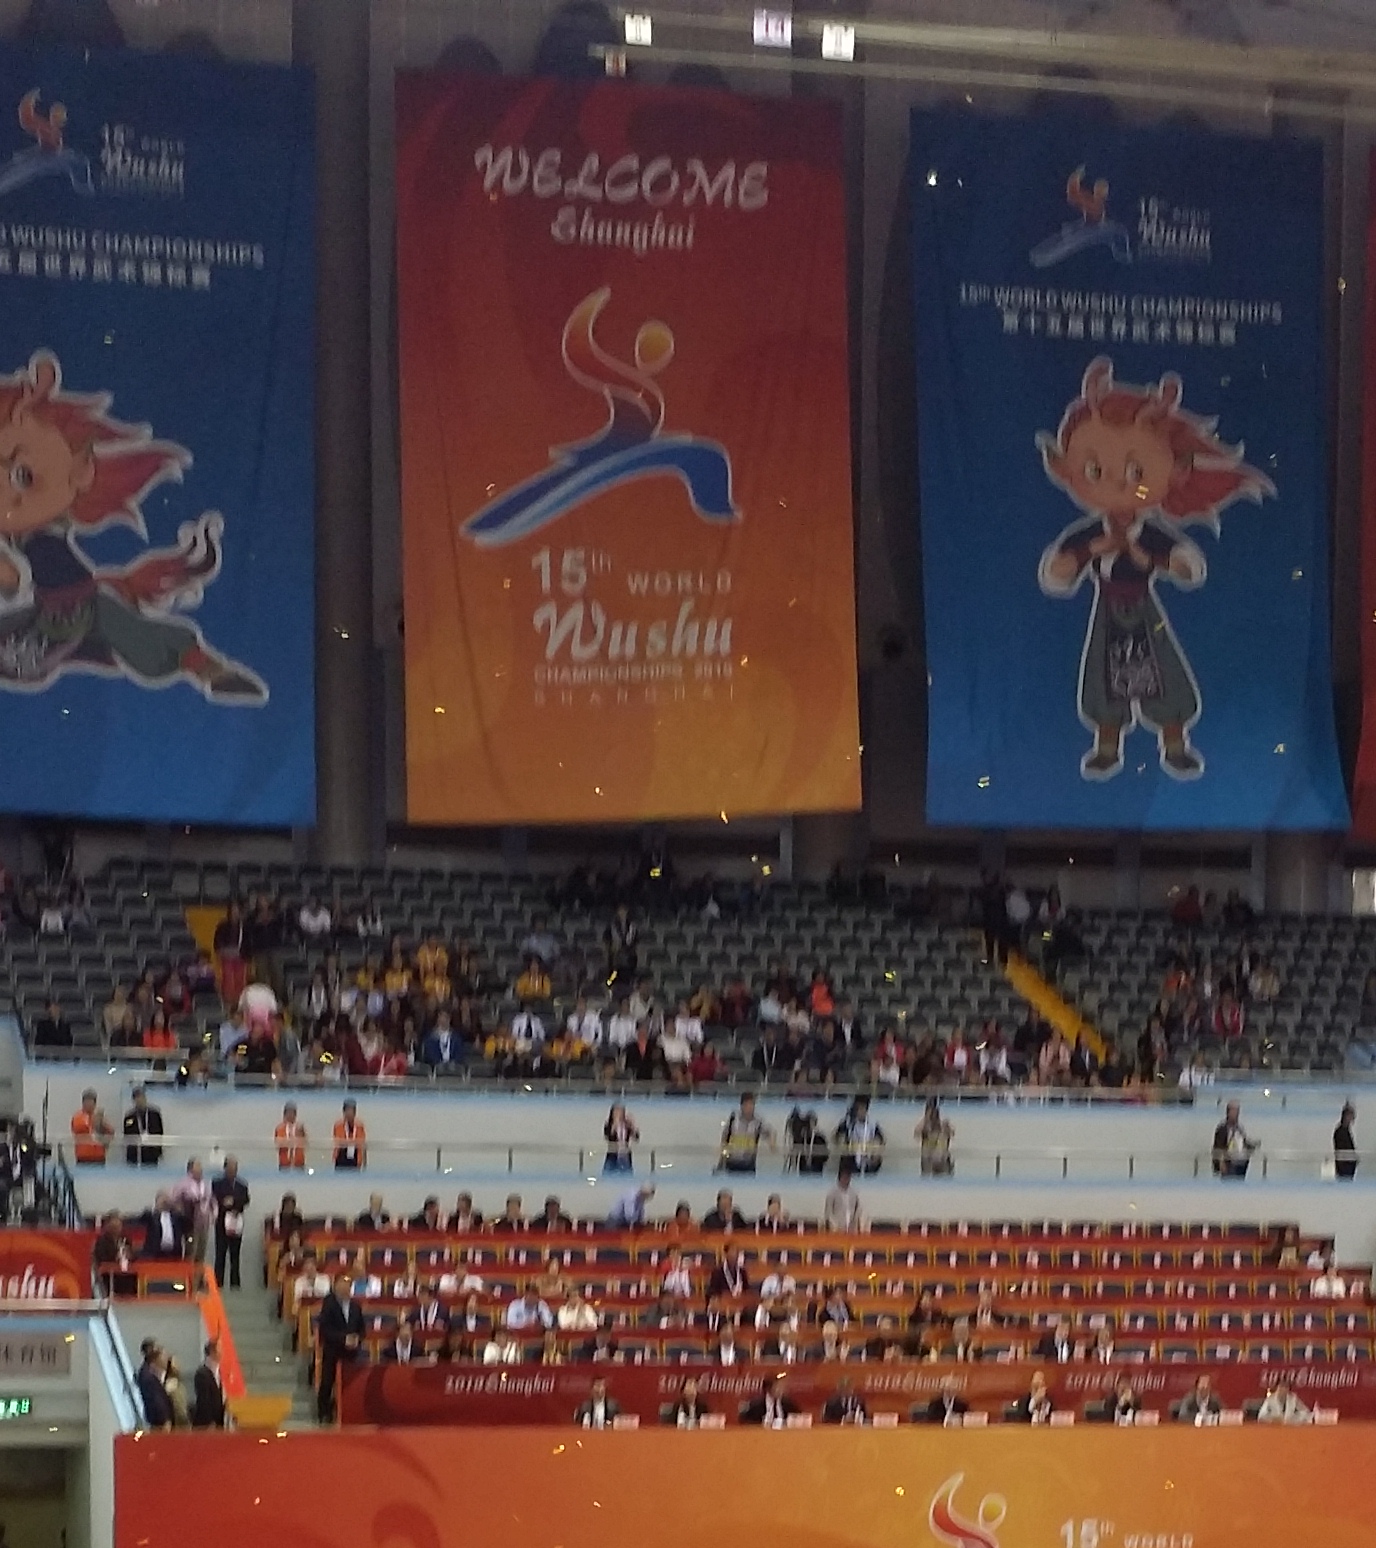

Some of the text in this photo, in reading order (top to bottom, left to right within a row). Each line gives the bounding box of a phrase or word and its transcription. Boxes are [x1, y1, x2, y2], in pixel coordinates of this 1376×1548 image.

[474, 143, 769, 211] WELCOME
[551, 205, 694, 257] Shanghai
[627, 570, 732, 596] WORLD
[532, 599, 733, 661] Wushu
